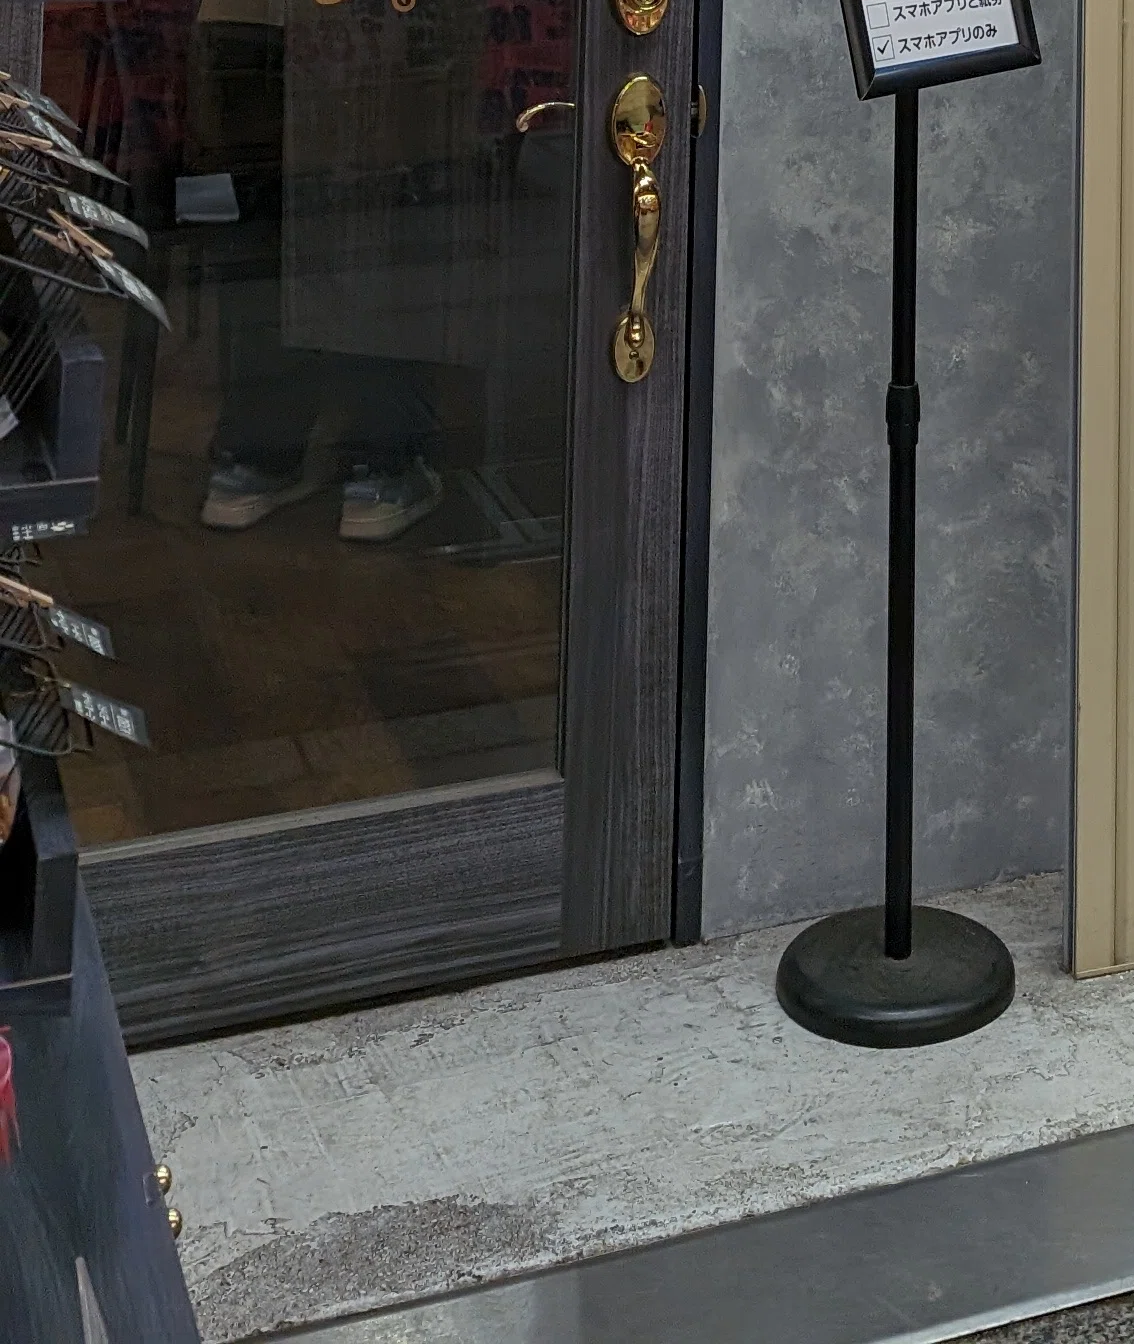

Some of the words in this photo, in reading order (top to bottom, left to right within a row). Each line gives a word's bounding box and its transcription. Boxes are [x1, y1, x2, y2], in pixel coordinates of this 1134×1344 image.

[898, 23, 998, 54] スマホアプリのみ
